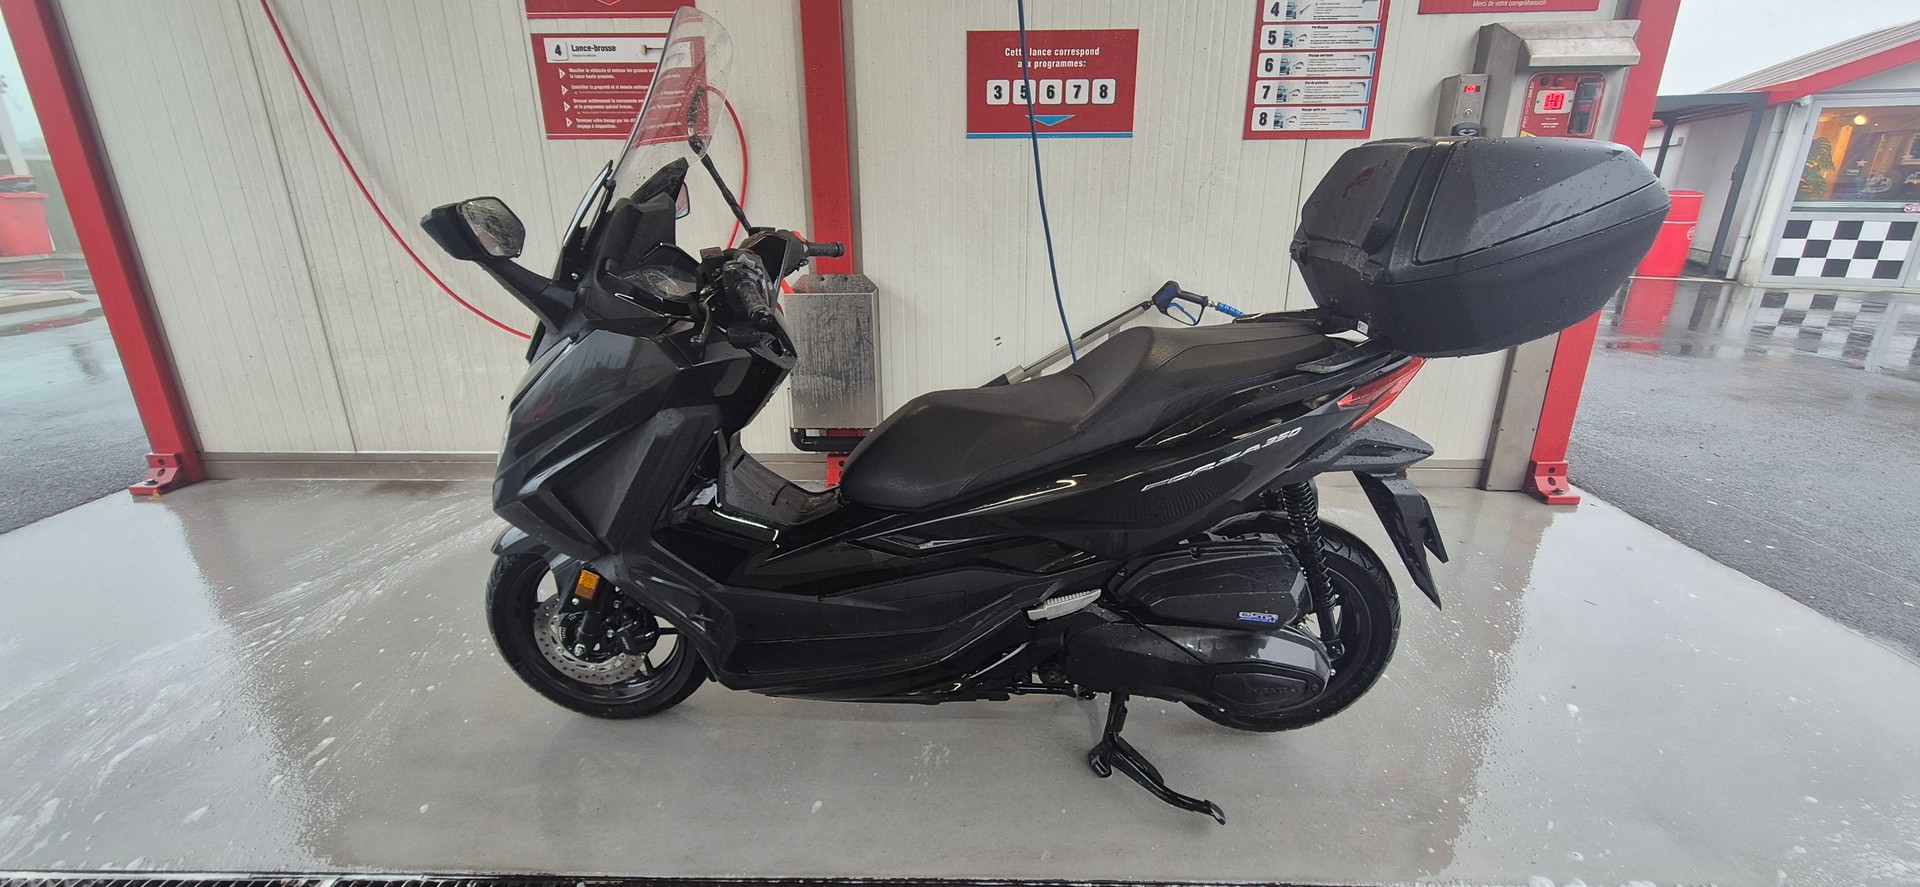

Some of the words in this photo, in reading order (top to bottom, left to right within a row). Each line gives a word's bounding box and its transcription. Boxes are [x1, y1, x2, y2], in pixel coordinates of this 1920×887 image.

[1270, 1, 1280, 17] 4
[1267, 30, 1277, 45] 5
[554, 44, 562, 56] 4
[571, 44, 616, 52] Lance-brosse
[1004, 47, 1026, 57] Cett
[1029, 48, 1052, 56] lance
[1054, 47, 1100, 57] correspond
[1017, 60, 1032, 68] ax
[1034, 60, 1086, 69] programmes:
[1264, 57, 1274, 72] 6
[993, 85, 1003, 99] 3
[1020, 85, 1028, 99] 5
[1046, 85, 1055, 99] 6
[1073, 85, 1082, 99] 7
[1099, 84, 1108, 99] 8
[1262, 85, 1271, 100] 7
[1259, 112, 1268, 126] 8
[1141, 444, 1260, 492] FORZA
[1261, 427, 1302, 448] 350
